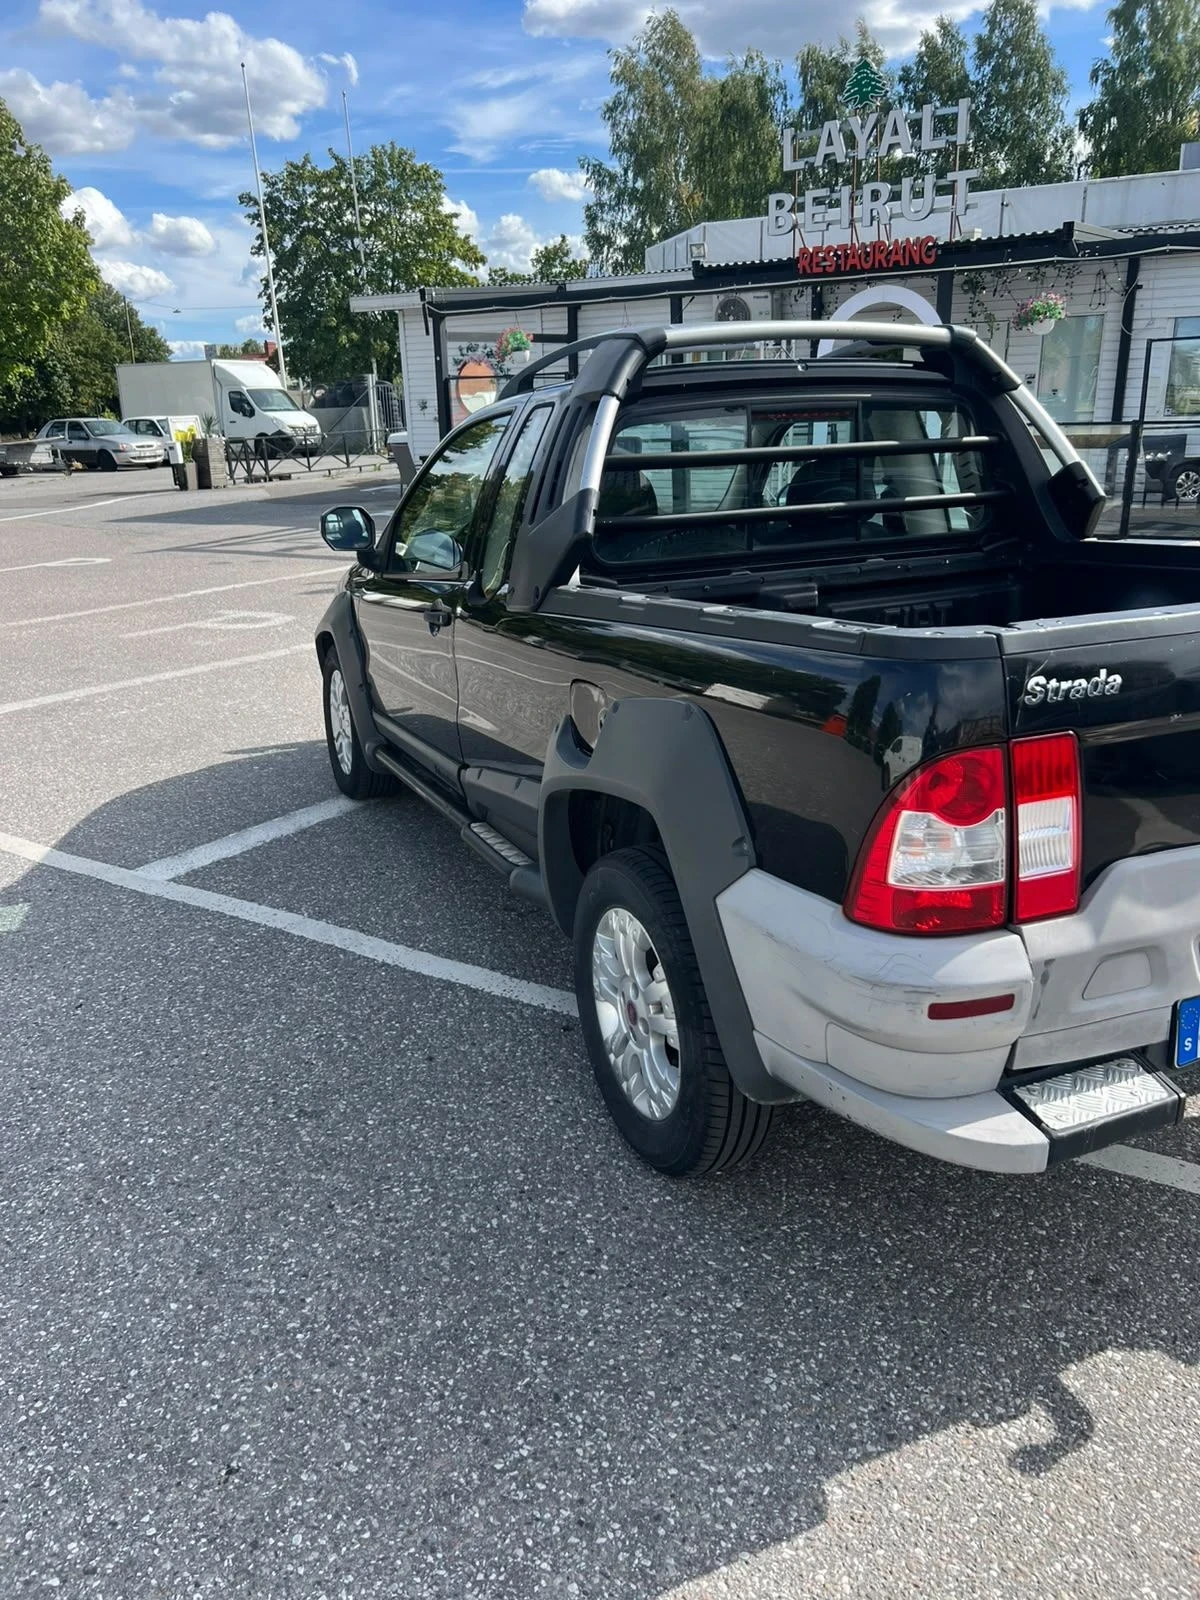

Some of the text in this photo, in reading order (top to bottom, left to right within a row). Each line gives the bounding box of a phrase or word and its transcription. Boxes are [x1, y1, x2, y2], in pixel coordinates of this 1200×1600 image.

[783, 98, 971, 171] LAYALI
[768, 170, 979, 236] BEIRUT
[798, 235, 937, 274] RESTAURANG
[1024, 668, 1123, 705] Strada
[1184, 1037, 1193, 1052] S
